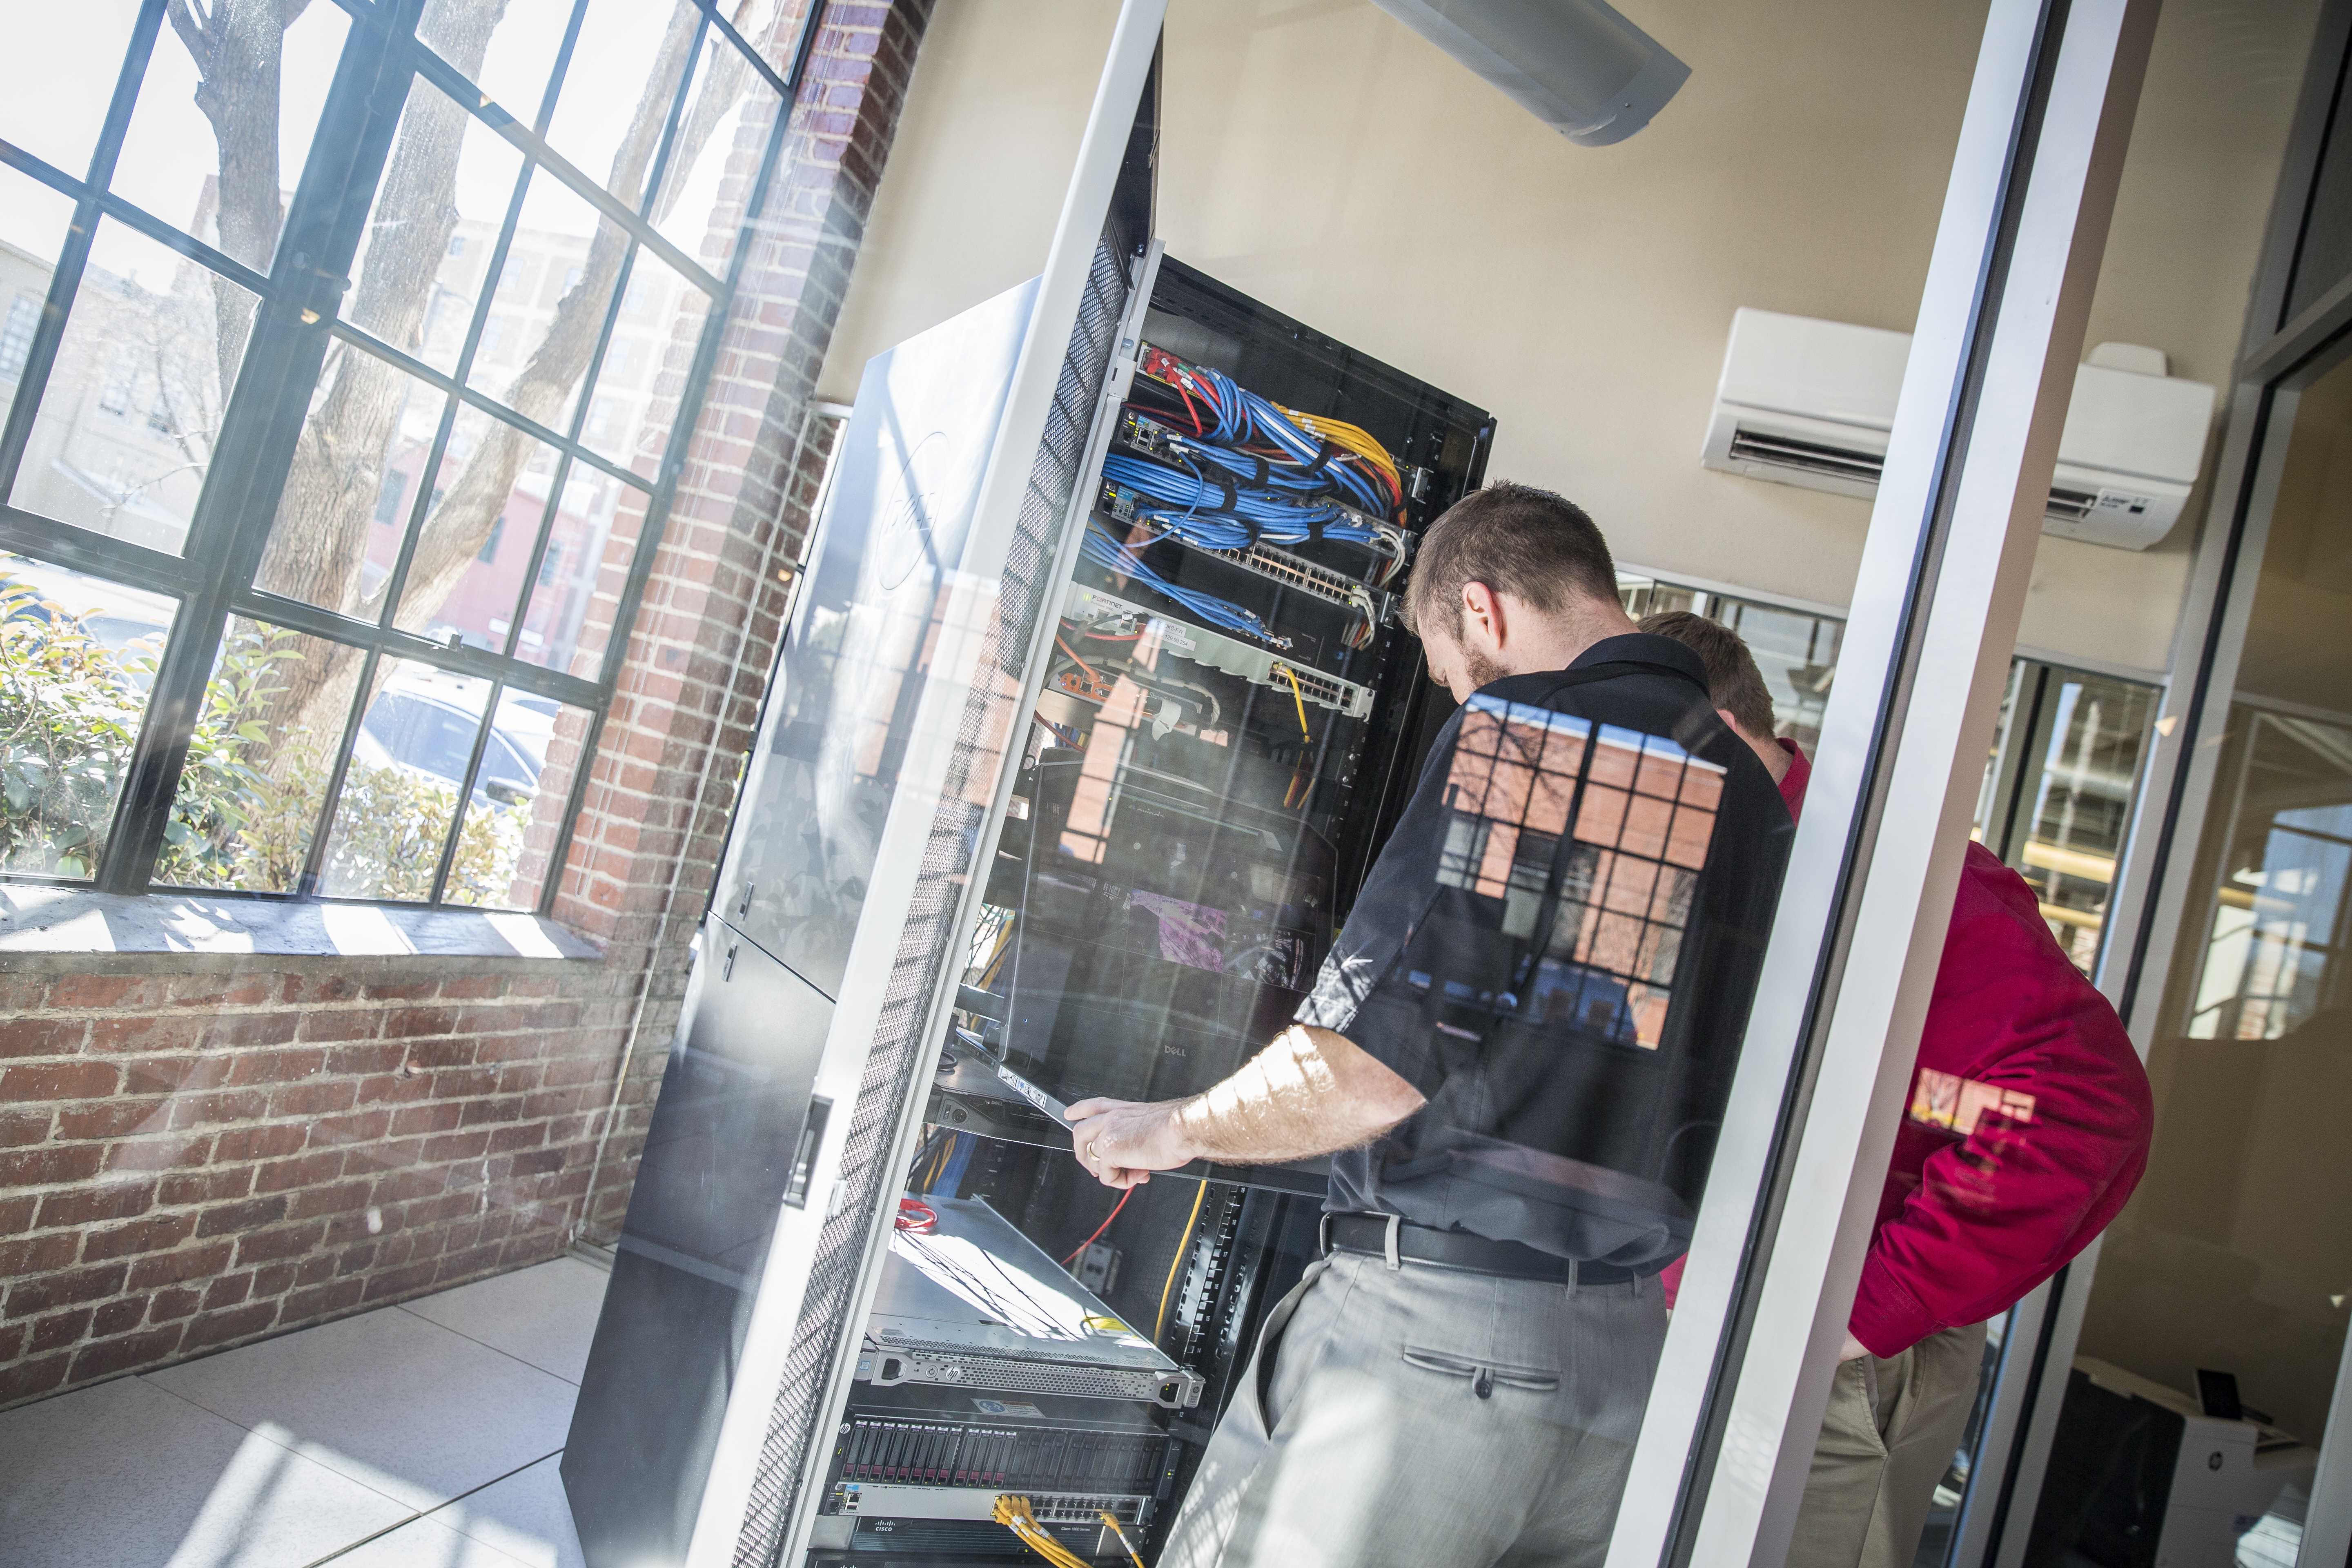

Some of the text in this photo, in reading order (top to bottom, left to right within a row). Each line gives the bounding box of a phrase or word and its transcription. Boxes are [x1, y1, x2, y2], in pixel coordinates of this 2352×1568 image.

[885, 492, 935, 537] DELL
[1092, 595, 1123, 610] FORTINET
[1157, 620, 1184, 634] SSOKC-FW
[1165, 1045, 1186, 1057] DELL
[947, 1366, 960, 1381] hp
[840, 1423, 850, 1434] hp
